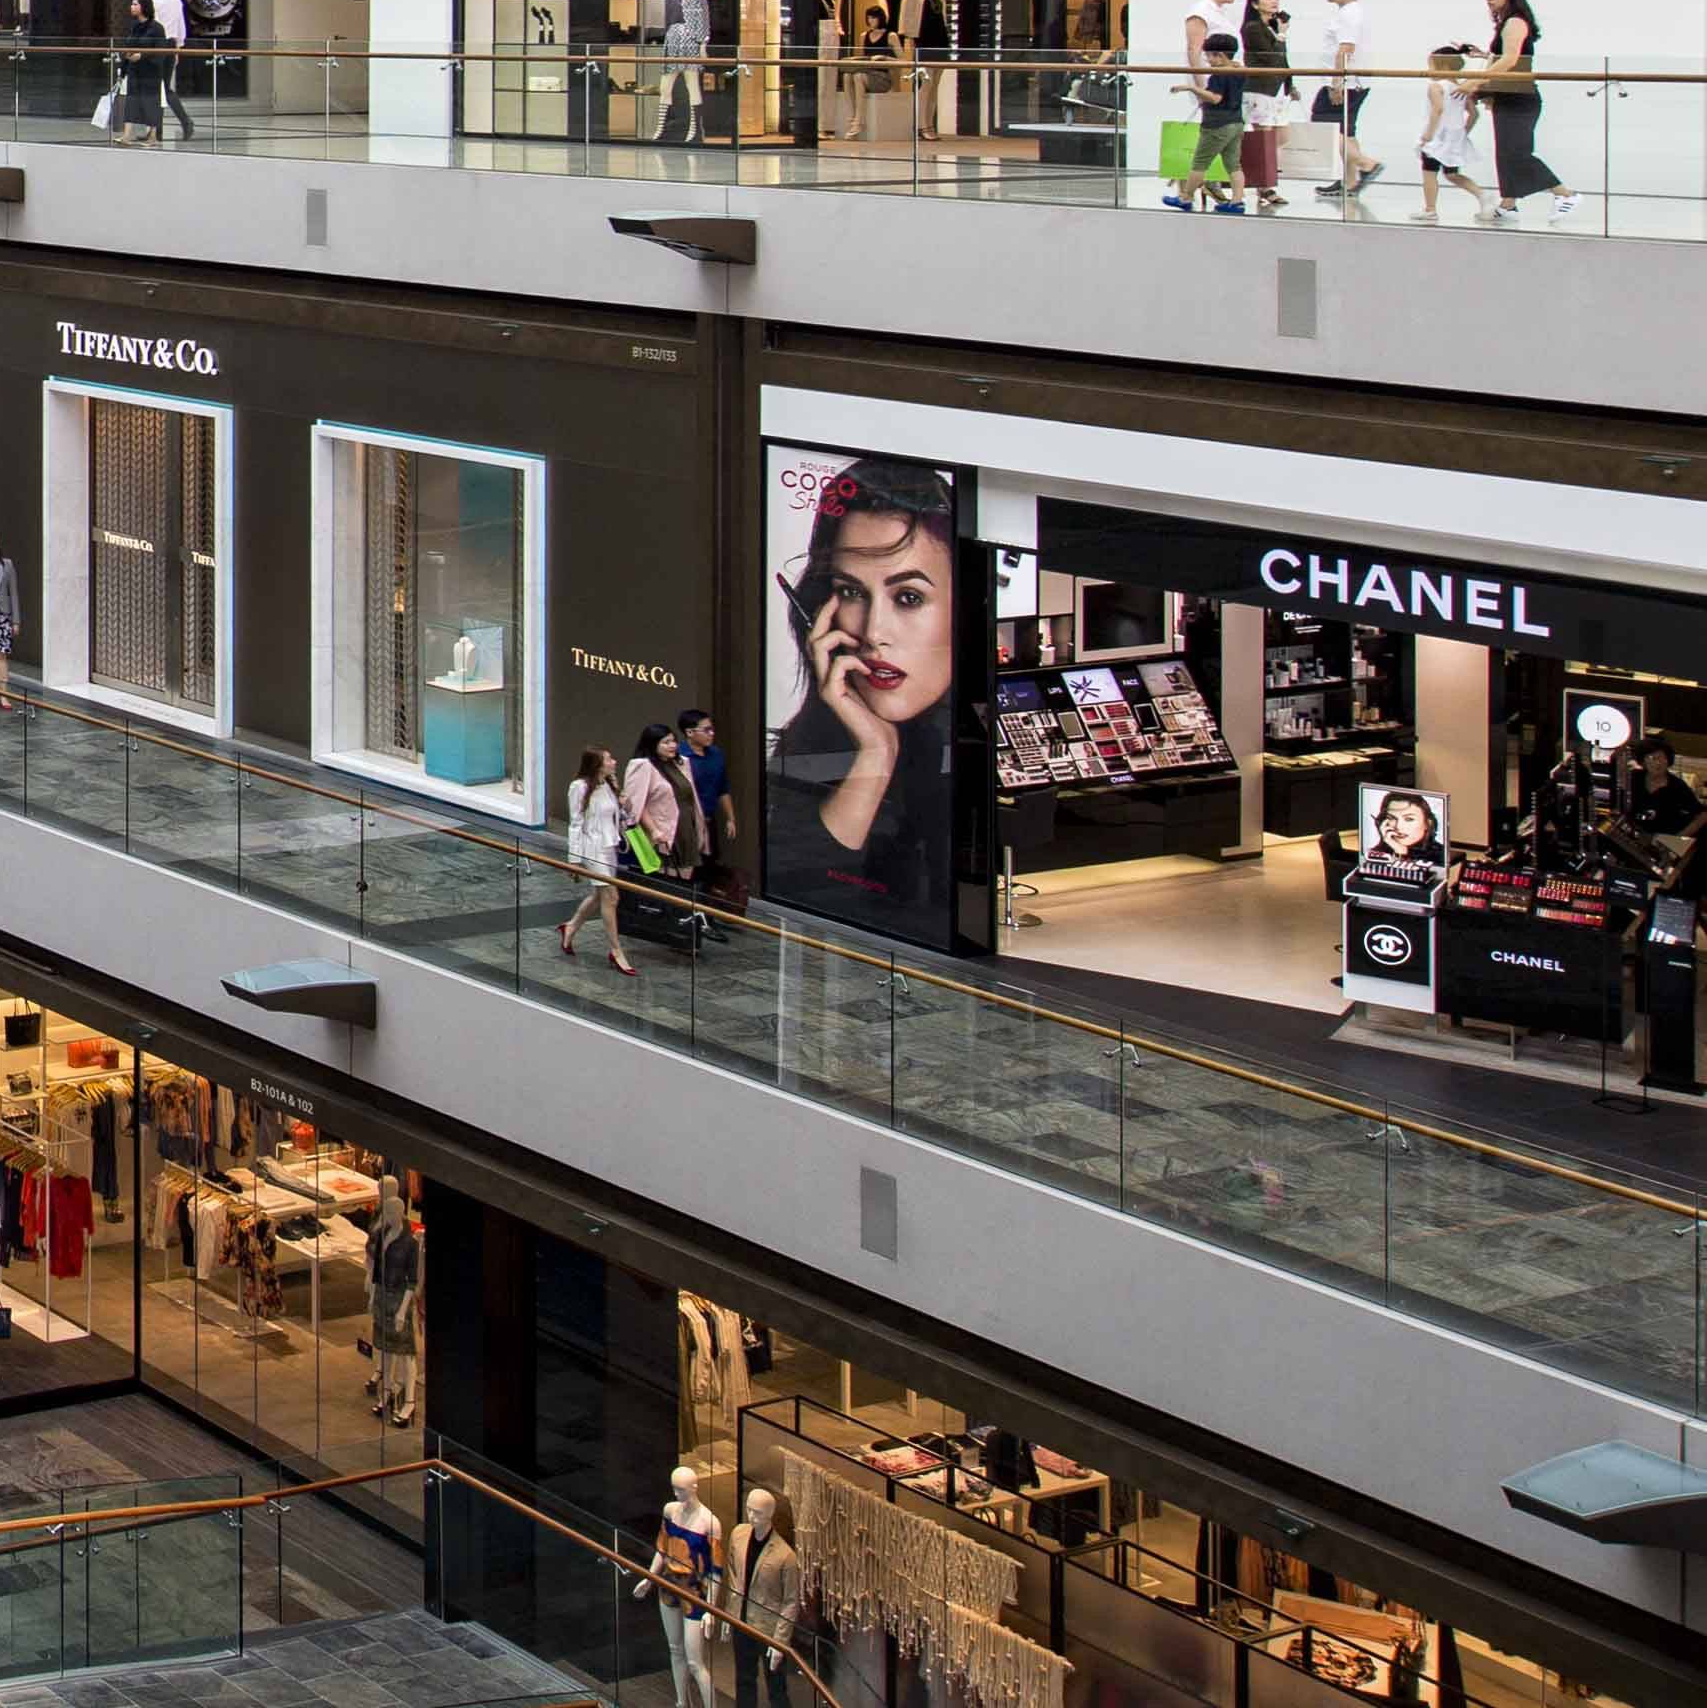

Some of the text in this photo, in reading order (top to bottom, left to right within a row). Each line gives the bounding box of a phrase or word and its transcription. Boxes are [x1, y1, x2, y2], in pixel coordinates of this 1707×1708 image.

[780, 469, 858, 500] COCO
[1260, 548, 1550, 638] CHANEL
[1490, 949, 1566, 973] CHANEL
[250, 1077, 315, 1116] B2-101A & 102
